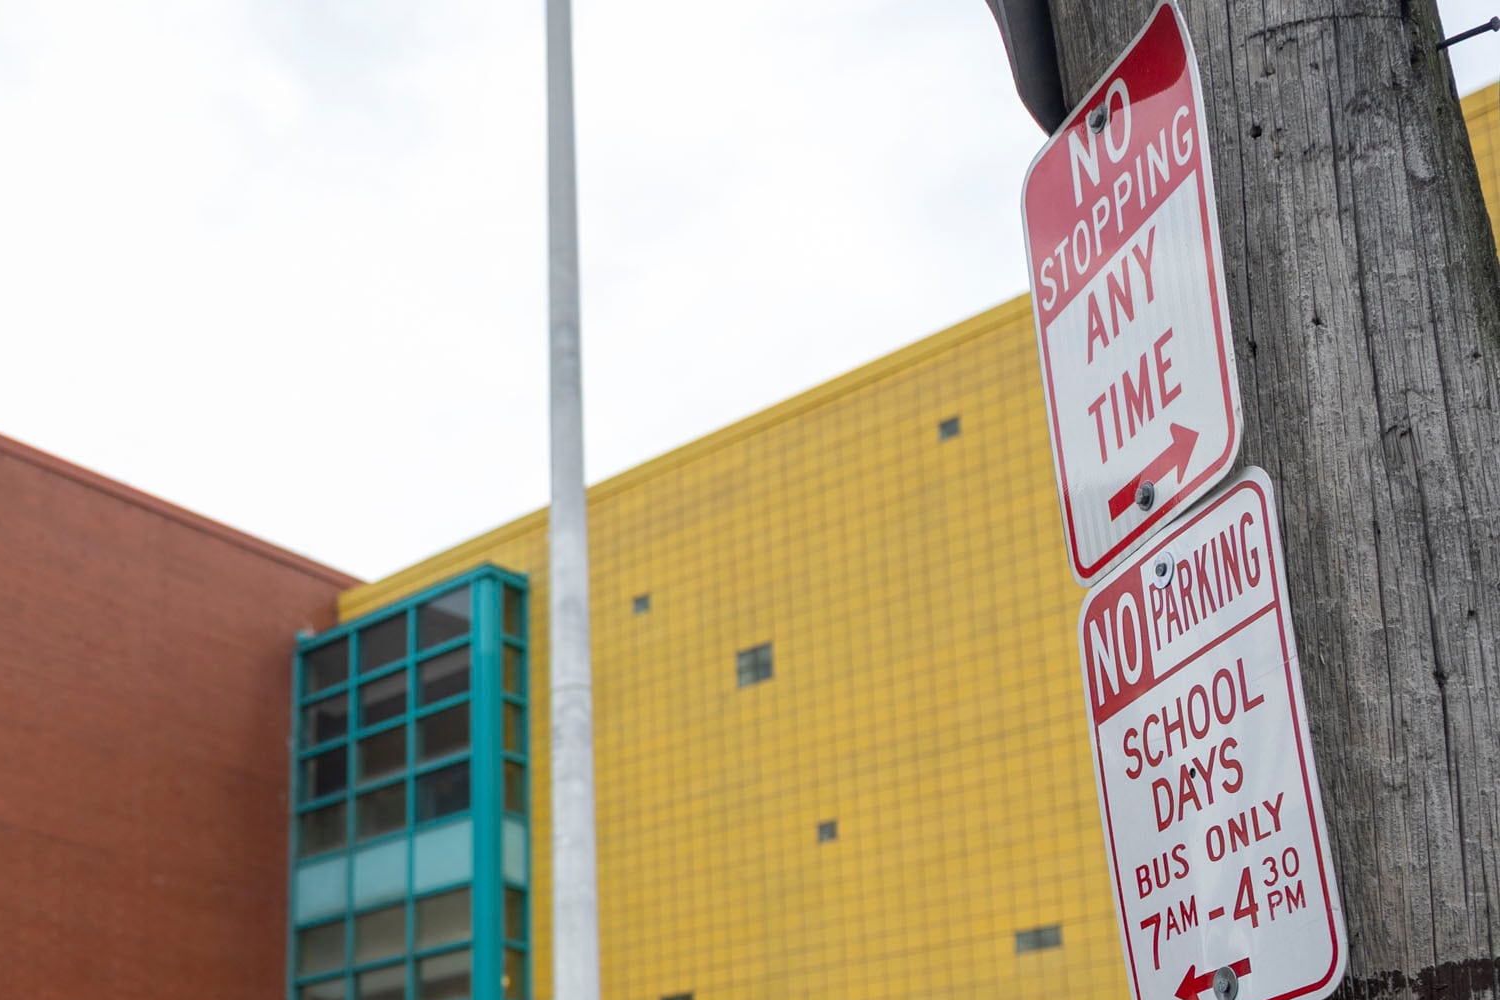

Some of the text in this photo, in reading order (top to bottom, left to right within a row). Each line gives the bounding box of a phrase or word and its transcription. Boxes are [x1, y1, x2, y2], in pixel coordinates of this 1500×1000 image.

[1040, 105, 1194, 311] STOPPING
[1068, 78, 1132, 208] NO
[1087, 225, 1156, 365] ANY
[1087, 327, 1182, 464] TIME
[1089, 511, 1261, 707] NO PARKING
[1123, 658, 1265, 780] SCHOOL
[1151, 737, 1243, 832] DAYS
[1135, 792, 1284, 899] BUS ONLY
